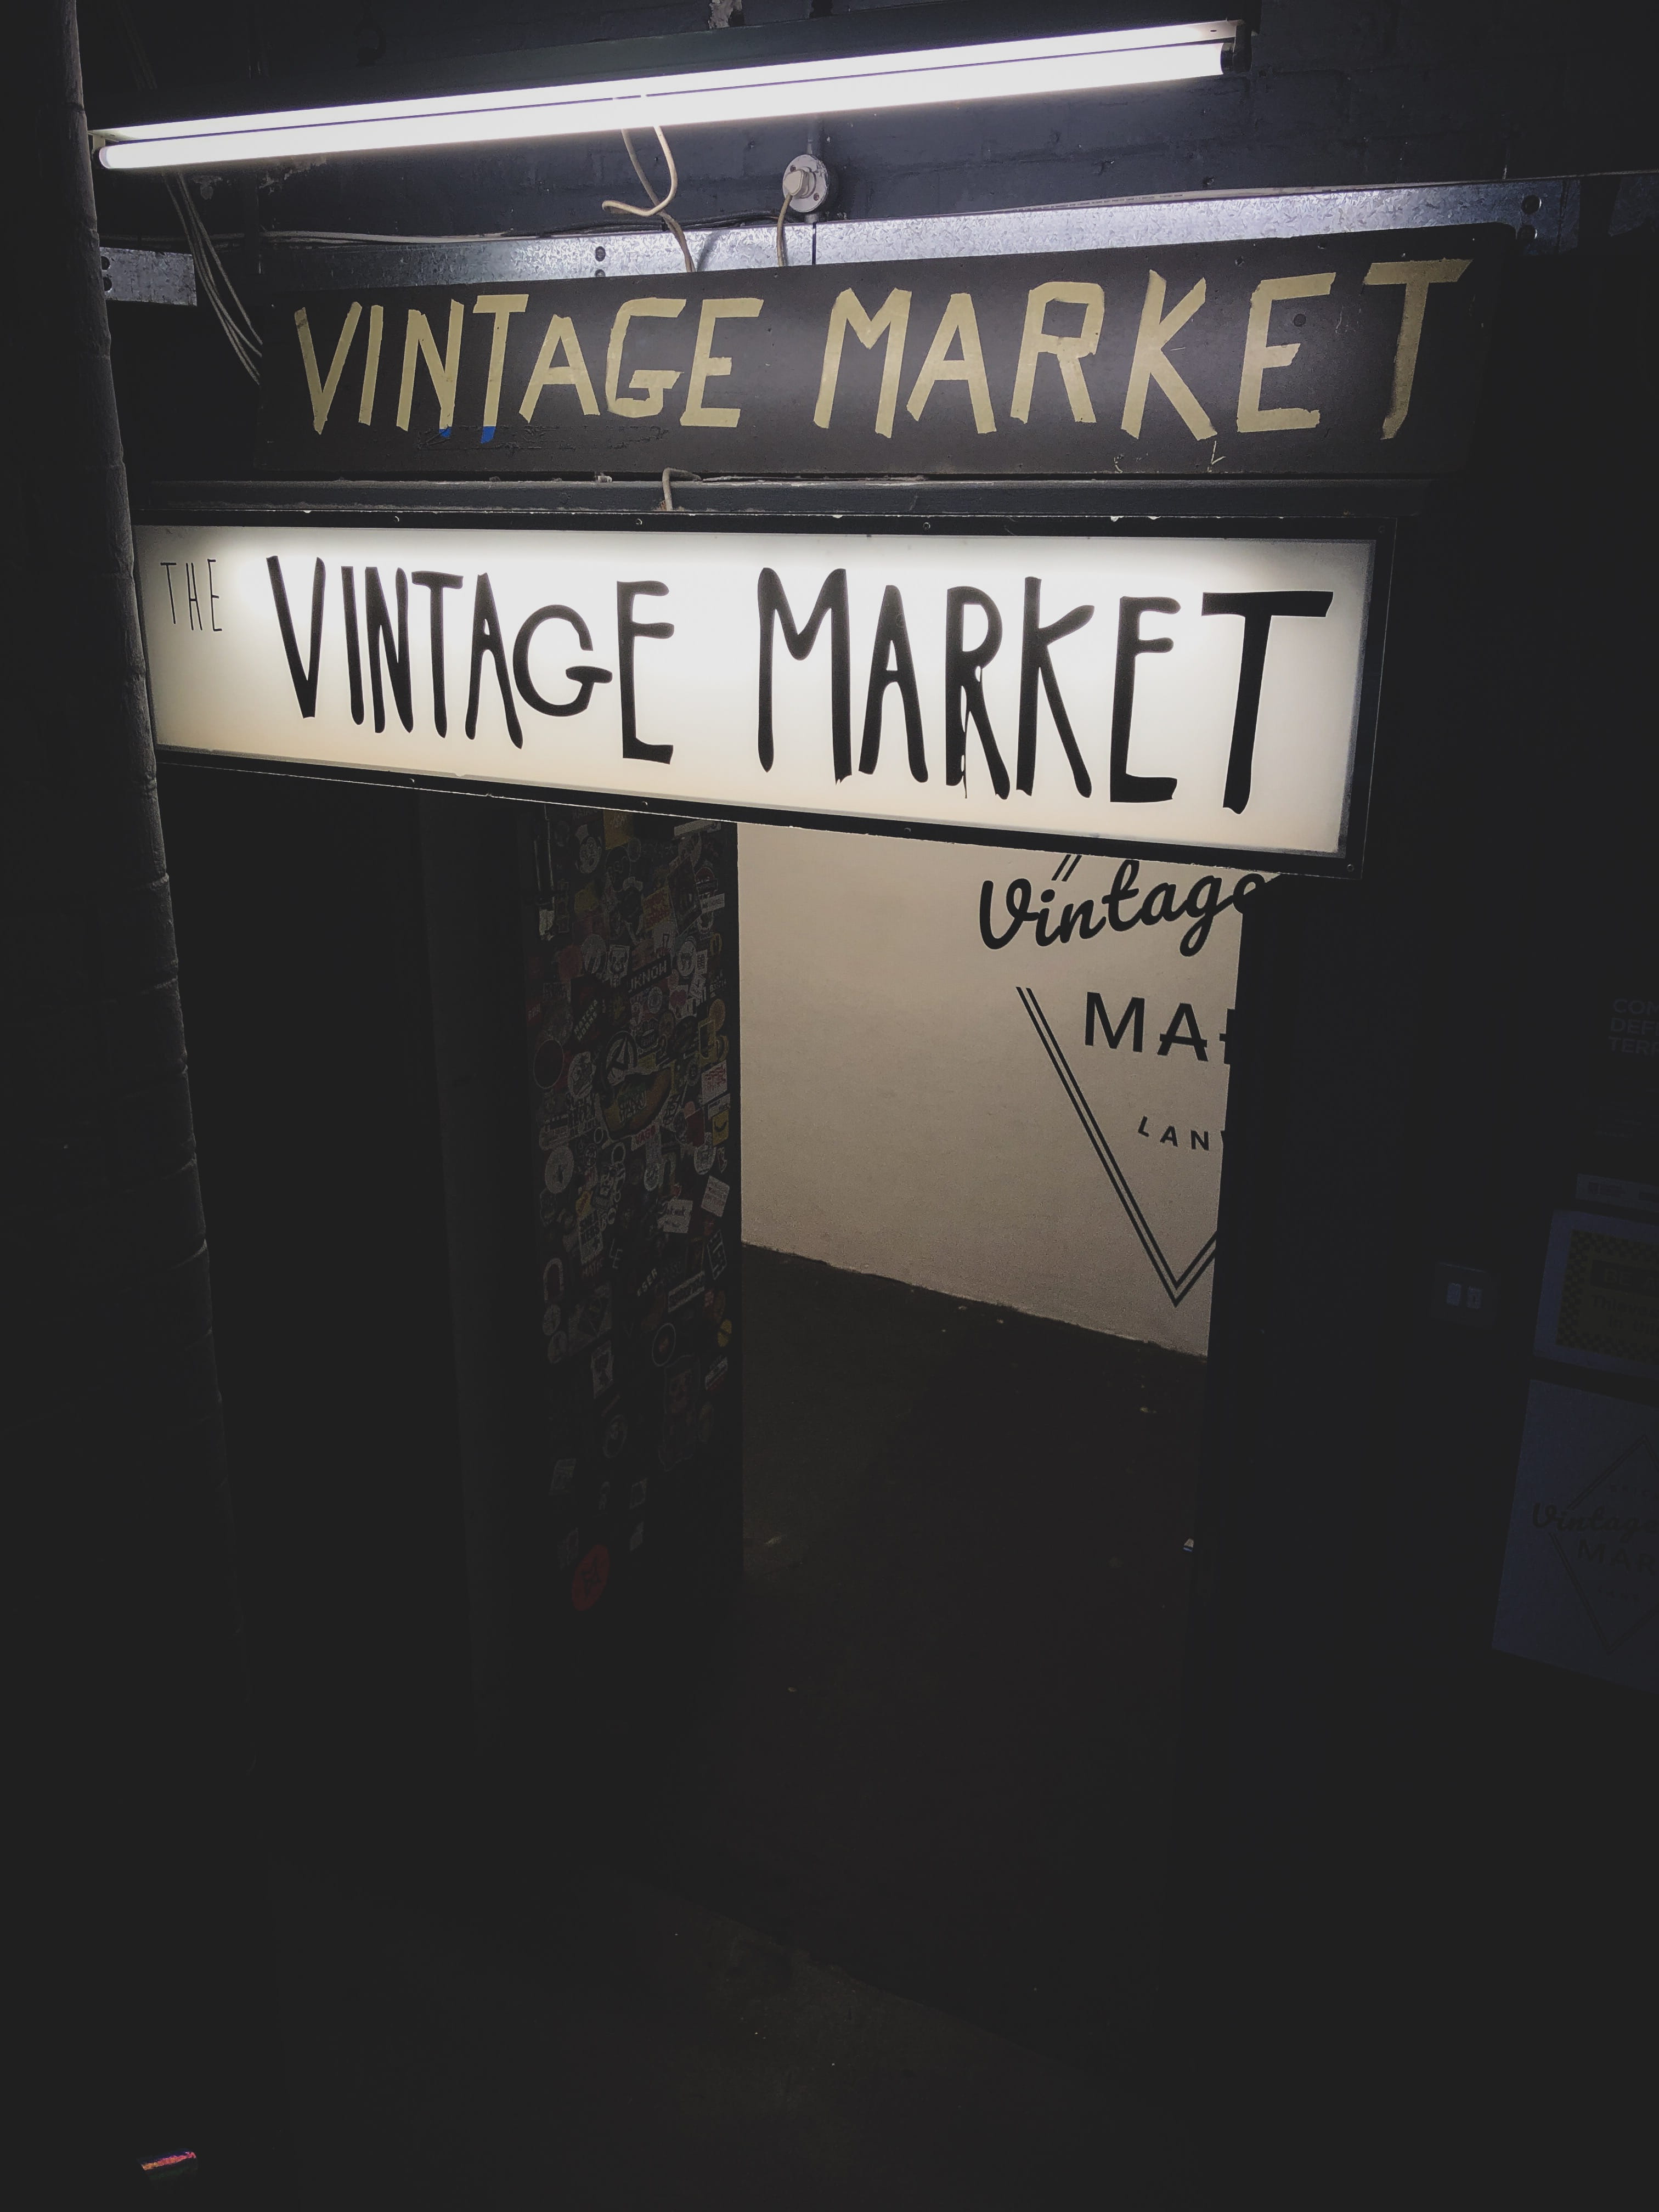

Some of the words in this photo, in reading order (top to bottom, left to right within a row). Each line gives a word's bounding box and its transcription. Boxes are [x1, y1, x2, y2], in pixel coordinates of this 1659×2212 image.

[294, 294, 764, 444] VINTAGE
[812, 258, 1473, 441] MARKET
[160, 558, 222, 632] THE
[266, 555, 675, 765] VINTAGE
[757, 567, 1333, 815] MARKET
[1084, 991, 1238, 1065] MA
[1138, 1116, 1226, 1152] LAN
